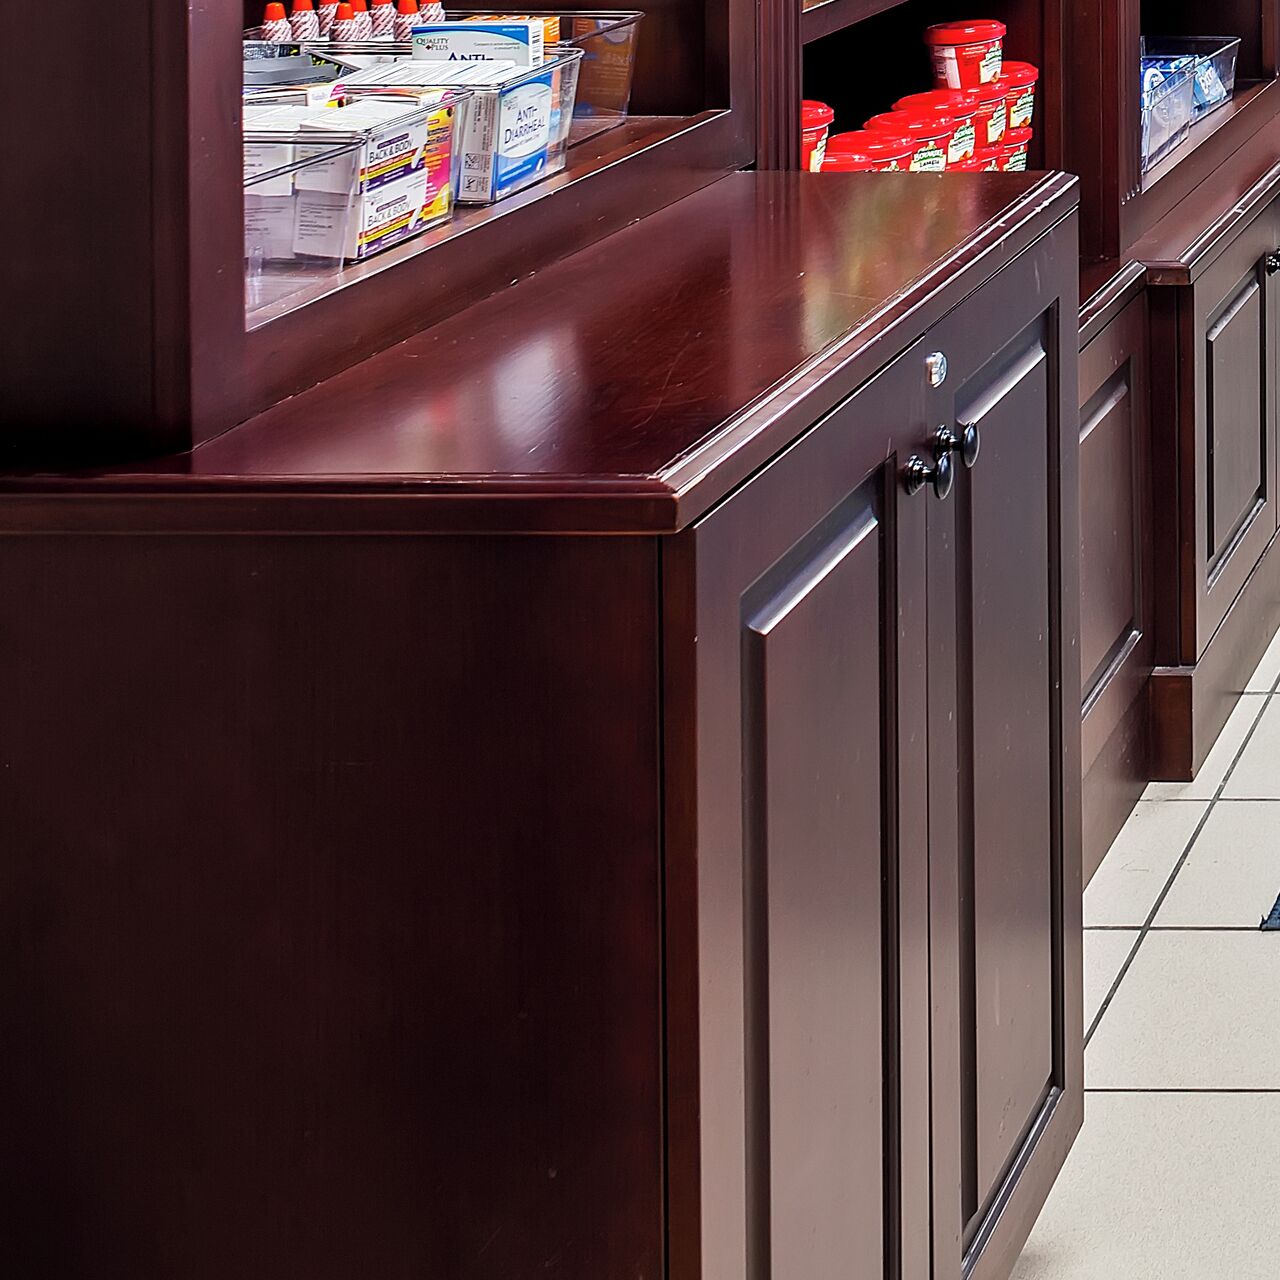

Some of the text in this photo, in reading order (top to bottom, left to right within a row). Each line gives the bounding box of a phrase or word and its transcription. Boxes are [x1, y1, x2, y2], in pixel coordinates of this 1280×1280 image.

[416, 37, 449, 45] QUALITY
[516, 106, 538, 122] ANTI-
[504, 116, 545, 144] DIARRHEAL
